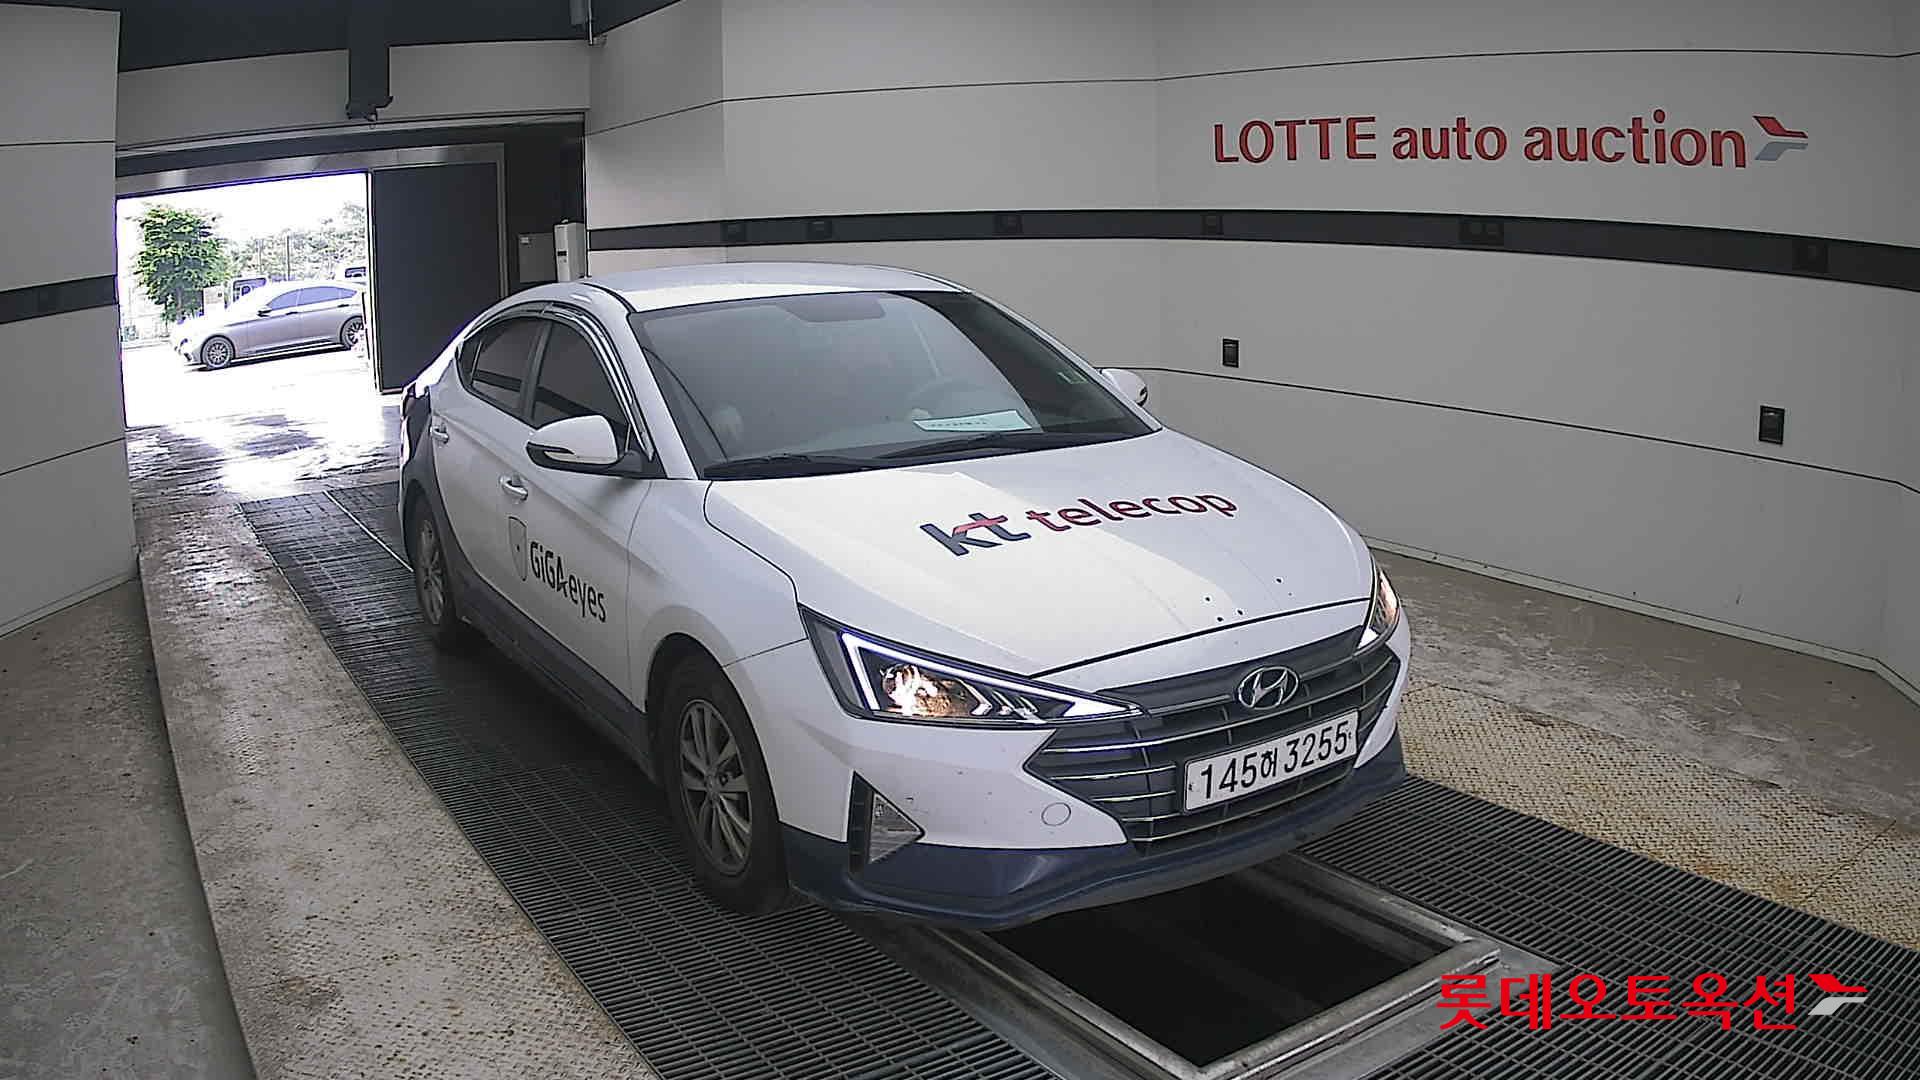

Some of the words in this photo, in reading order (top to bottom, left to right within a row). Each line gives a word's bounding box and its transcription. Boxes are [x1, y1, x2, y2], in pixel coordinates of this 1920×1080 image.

[1213, 115, 1378, 163] LOTTE
[1392, 115, 1508, 161] auto
[1523, 108, 1748, 169] auction
[919, 512, 1032, 557] kt
[1025, 493, 1238, 532] telecop
[1200, 747, 1278, 799] 145허
[1283, 720, 1349, 772] 3255
